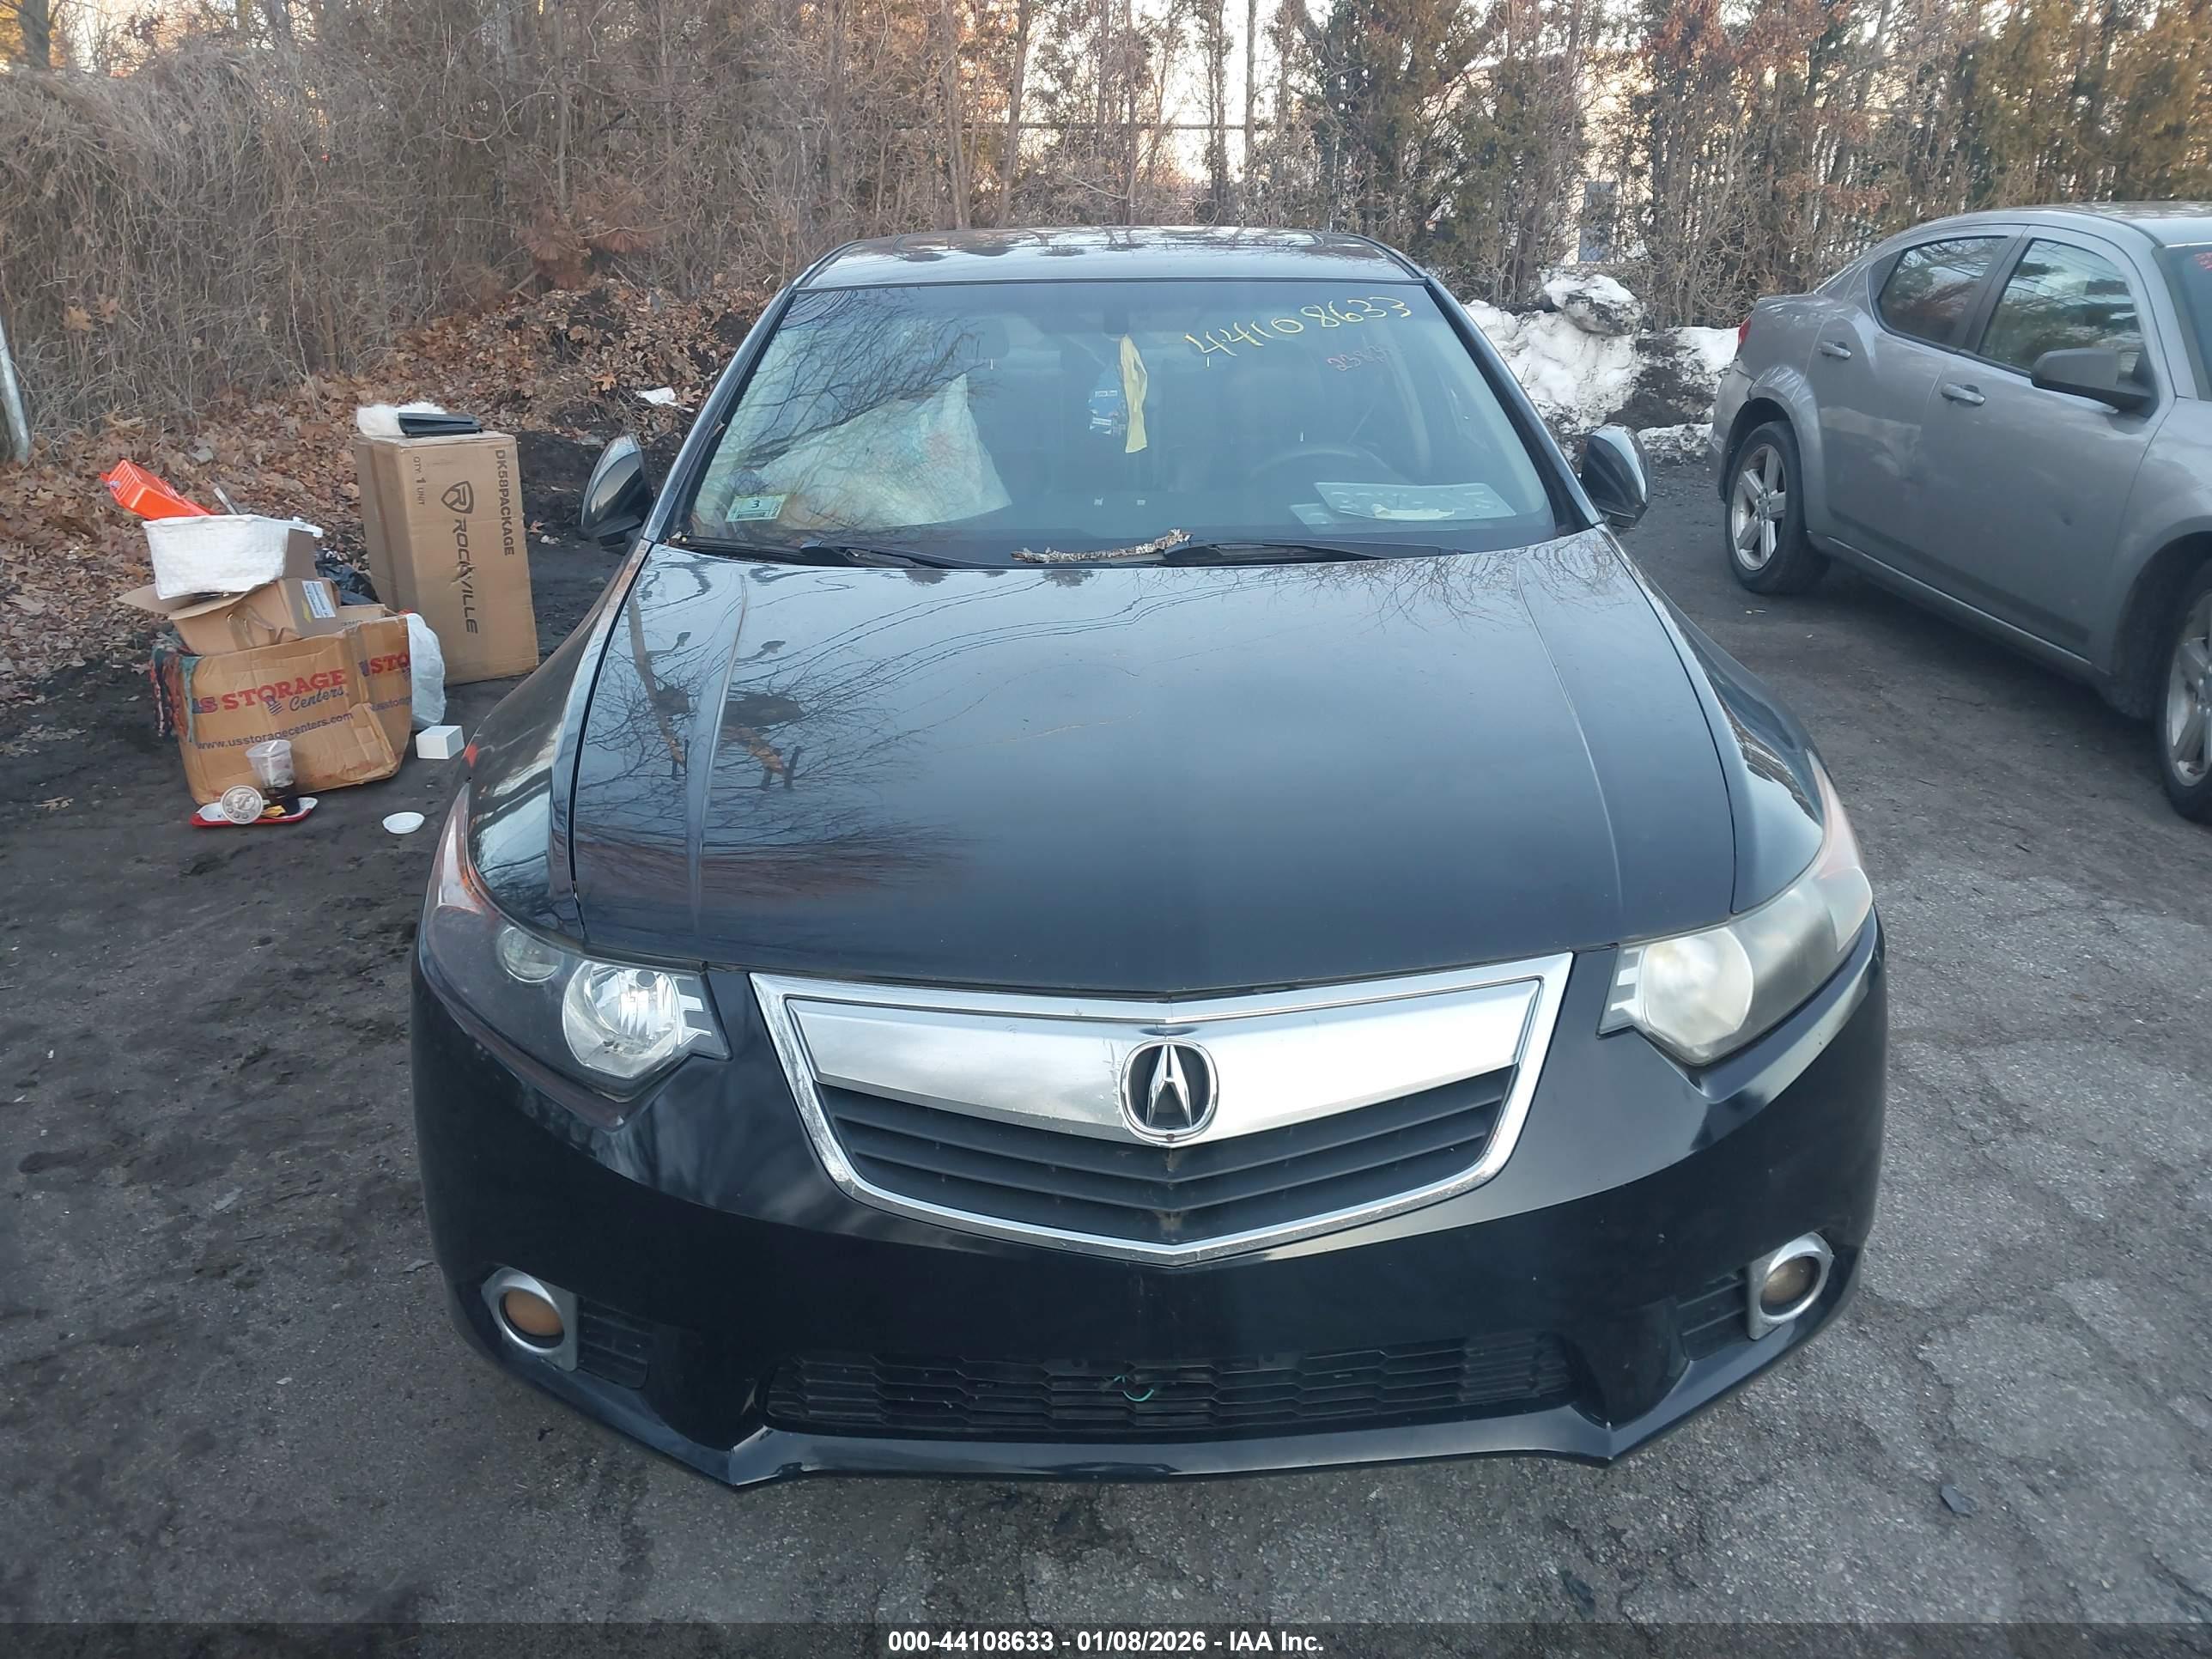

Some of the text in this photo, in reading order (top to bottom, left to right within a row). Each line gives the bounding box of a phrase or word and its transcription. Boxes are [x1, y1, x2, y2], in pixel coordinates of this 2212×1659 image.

[1184, 297, 1412, 357] 44108633
[416, 487, 426, 505] UNIT
[495, 449, 515, 556] DK58PACKAGE
[750, 500, 761, 508] 3
[222, 669, 347, 710] STORAGE
[197, 712, 354, 750] www.usstoragecenters.com
